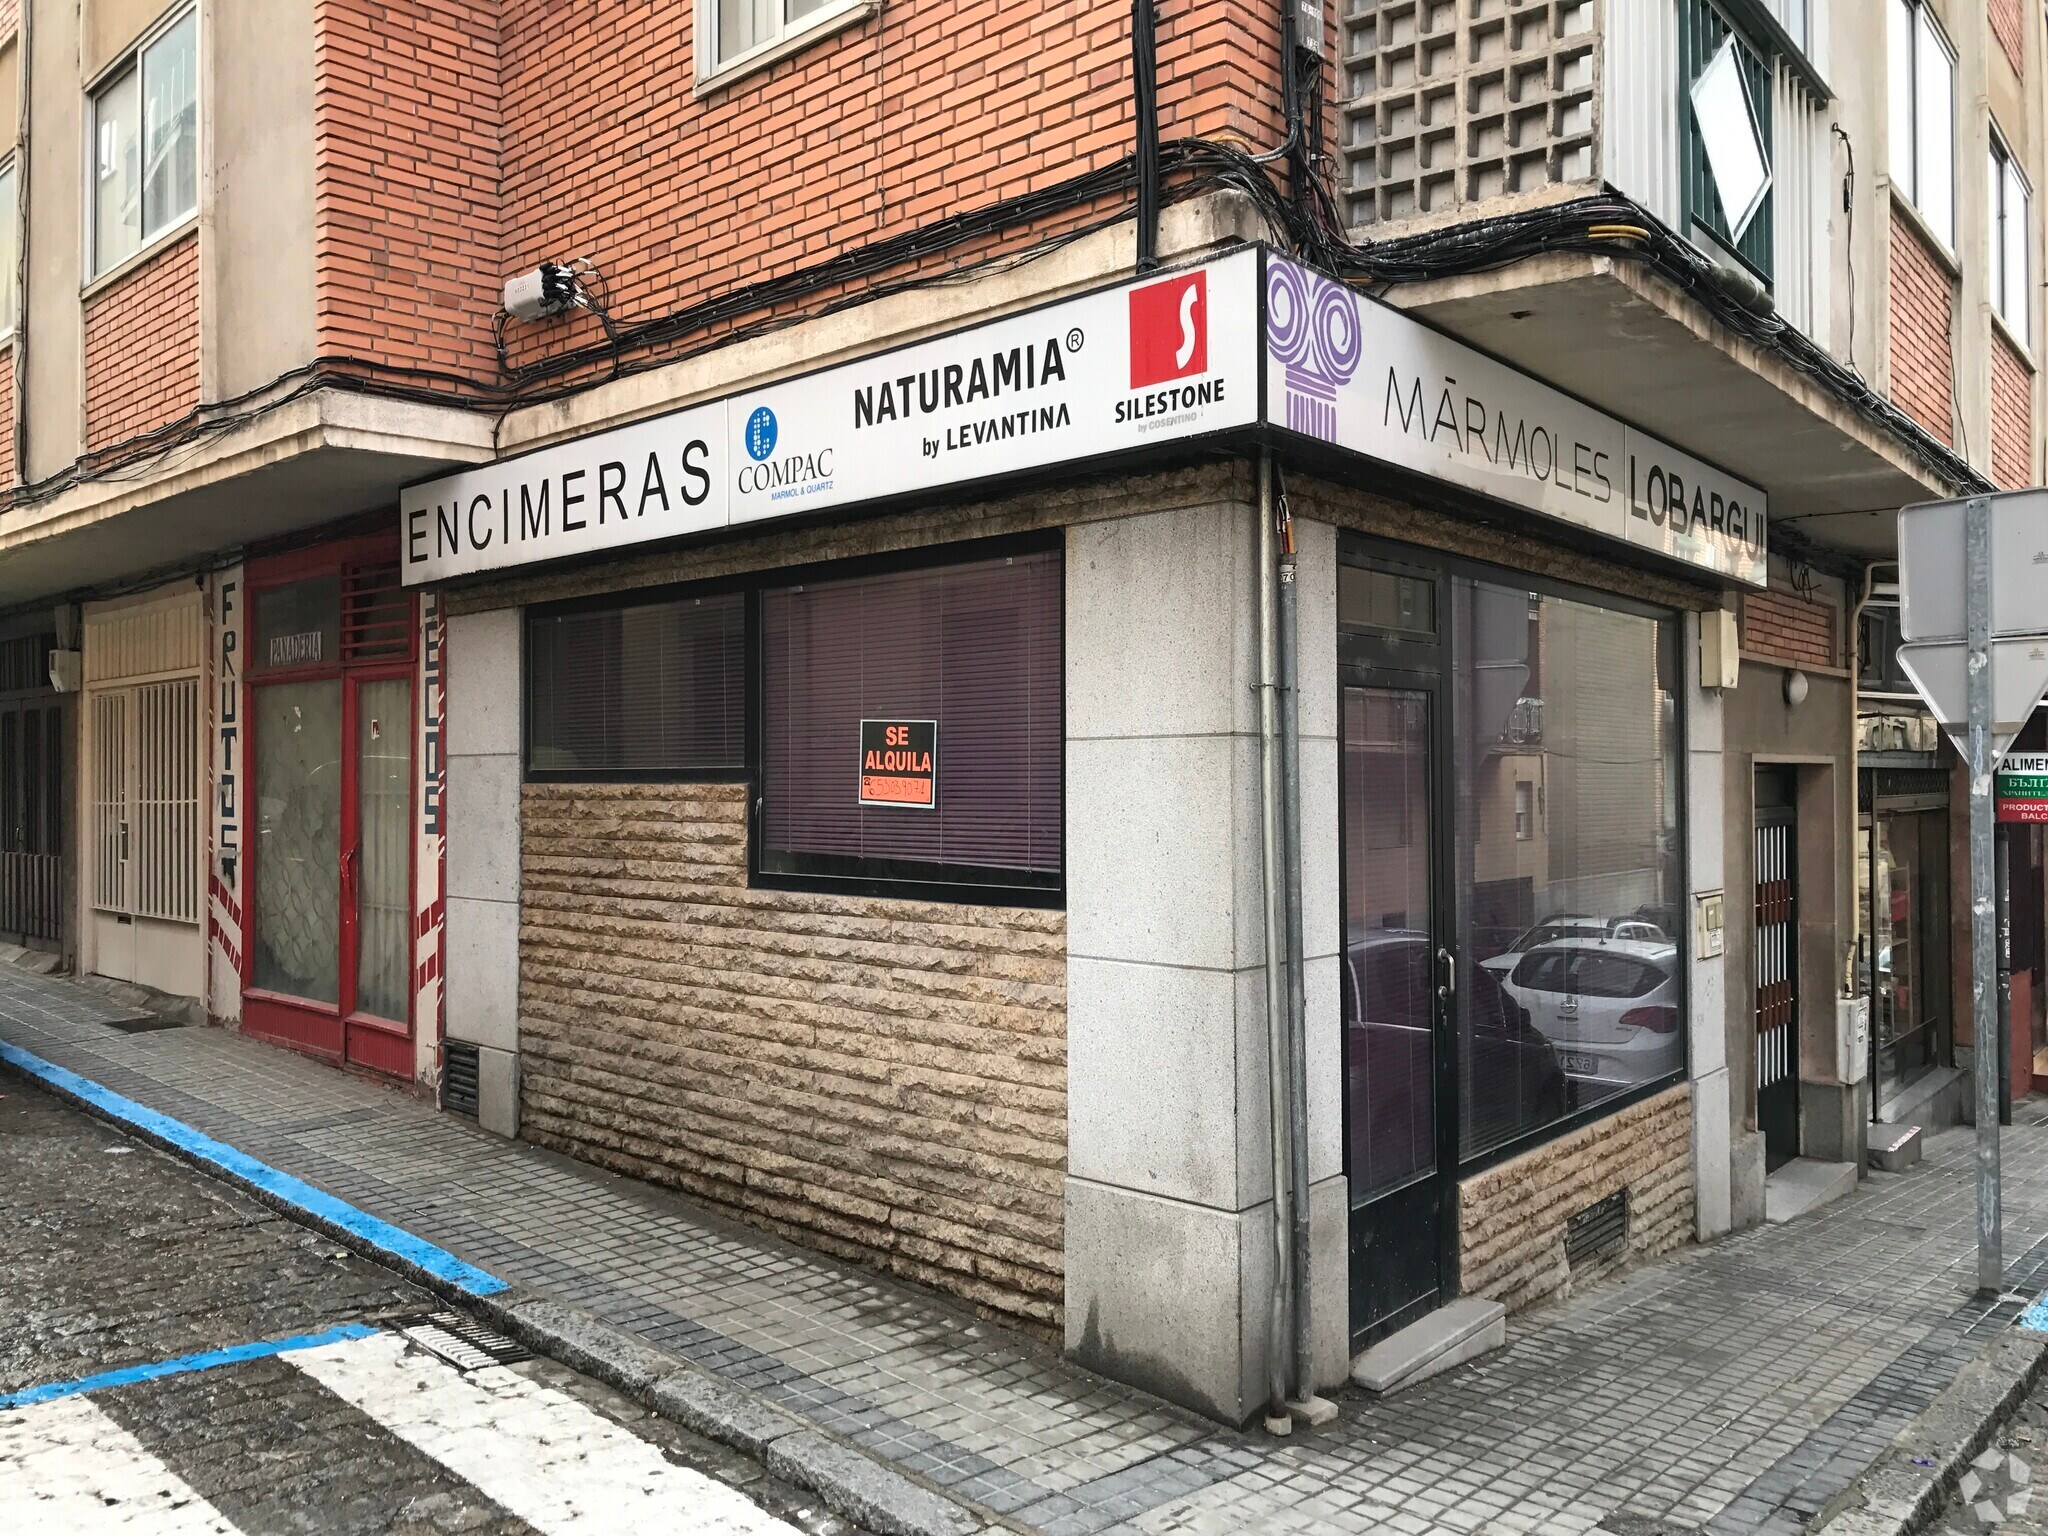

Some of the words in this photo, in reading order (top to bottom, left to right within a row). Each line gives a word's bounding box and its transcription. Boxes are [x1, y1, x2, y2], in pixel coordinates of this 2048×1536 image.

[1115, 378, 1225, 424] SILESTONE
[1137, 423, 1148, 433] by
[1148, 411, 1198, 430] COSENTINO
[922, 437, 940, 459] by
[946, 402, 1070, 452] LEVANTINA
[738, 448, 834, 494] COMPAC
[771, 488, 799, 501] MARMOL
[800, 486, 805, 496] &
[806, 480, 834, 493] QUARTZ
[408, 439, 711, 565] ENCIMERAS
[1630, 454, 1764, 562] LOBARGUI
[885, 726, 909, 746] SE
[865, 750, 932, 772] ALQUILA
